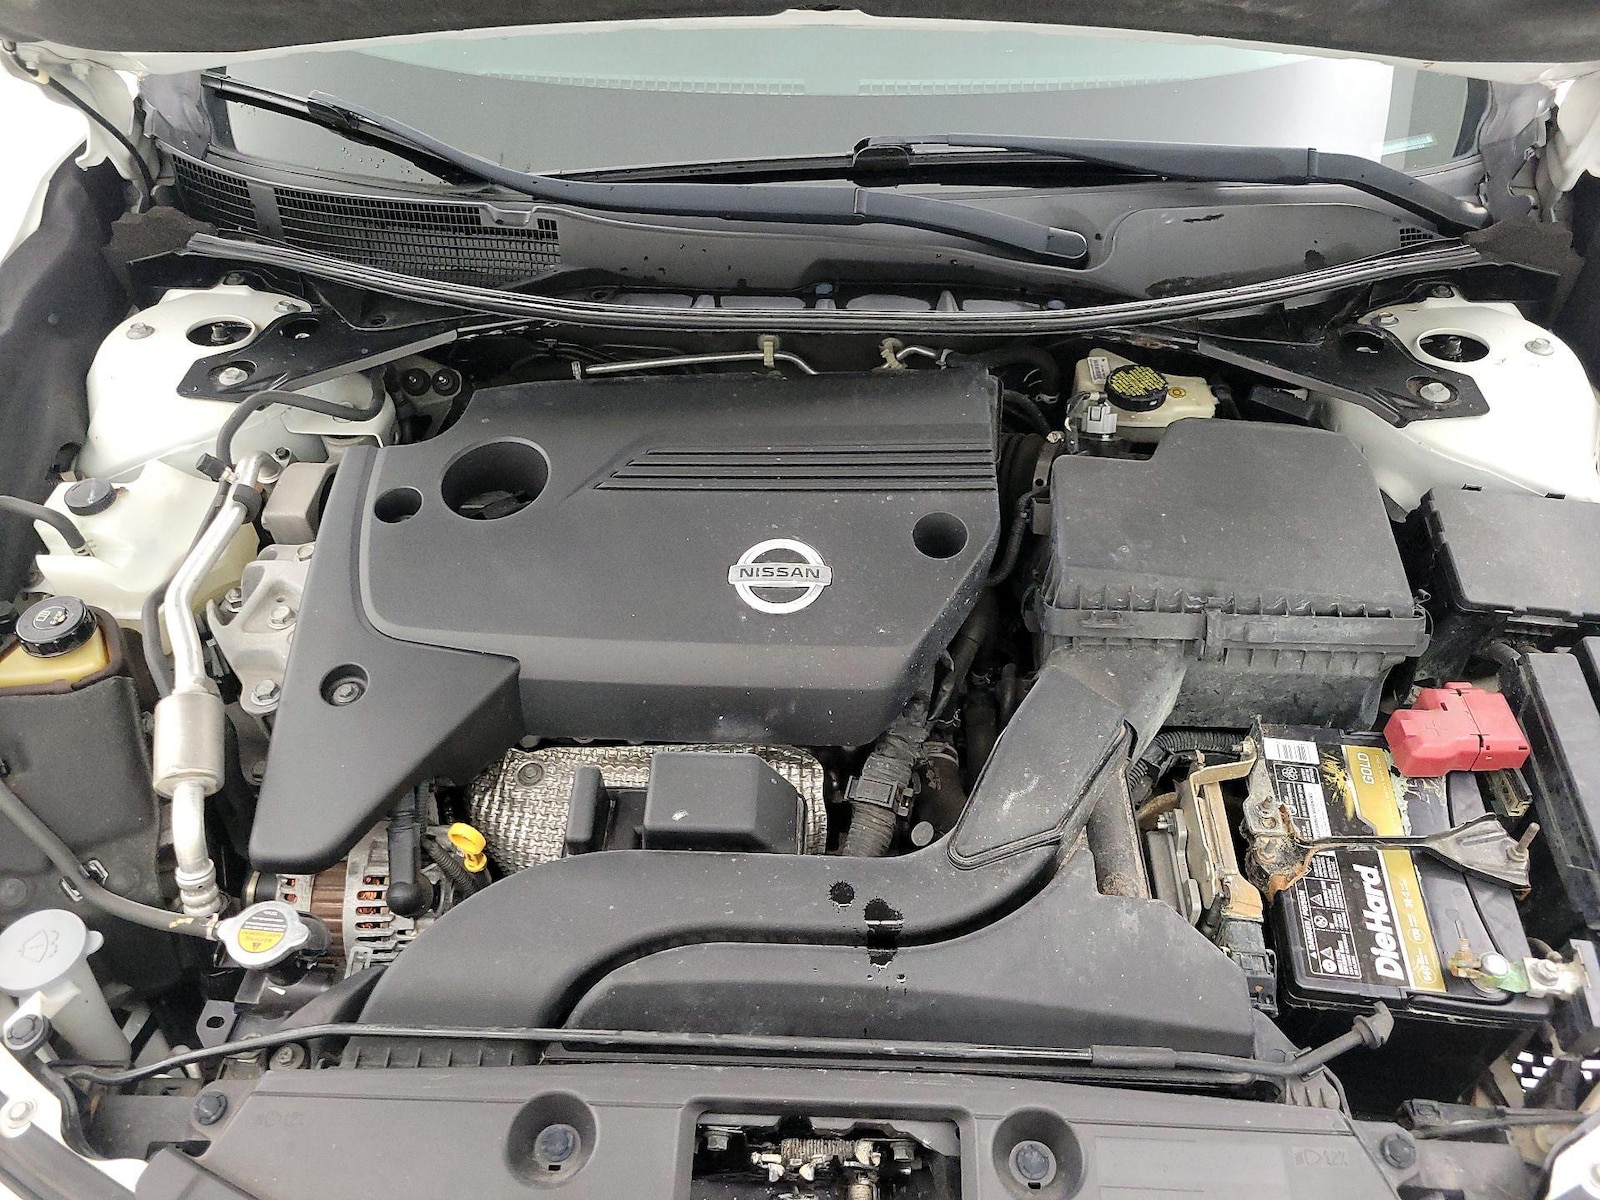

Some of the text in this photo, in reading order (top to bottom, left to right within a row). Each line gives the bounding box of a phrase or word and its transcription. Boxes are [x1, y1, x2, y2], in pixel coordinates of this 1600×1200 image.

[740, 567, 820, 579] NISSAN
[1357, 752, 1374, 785] GOLD
[1299, 889, 1310, 917] POISON
[1304, 920, 1316, 951] DANGER
[1352, 863, 1405, 980] DieHard
